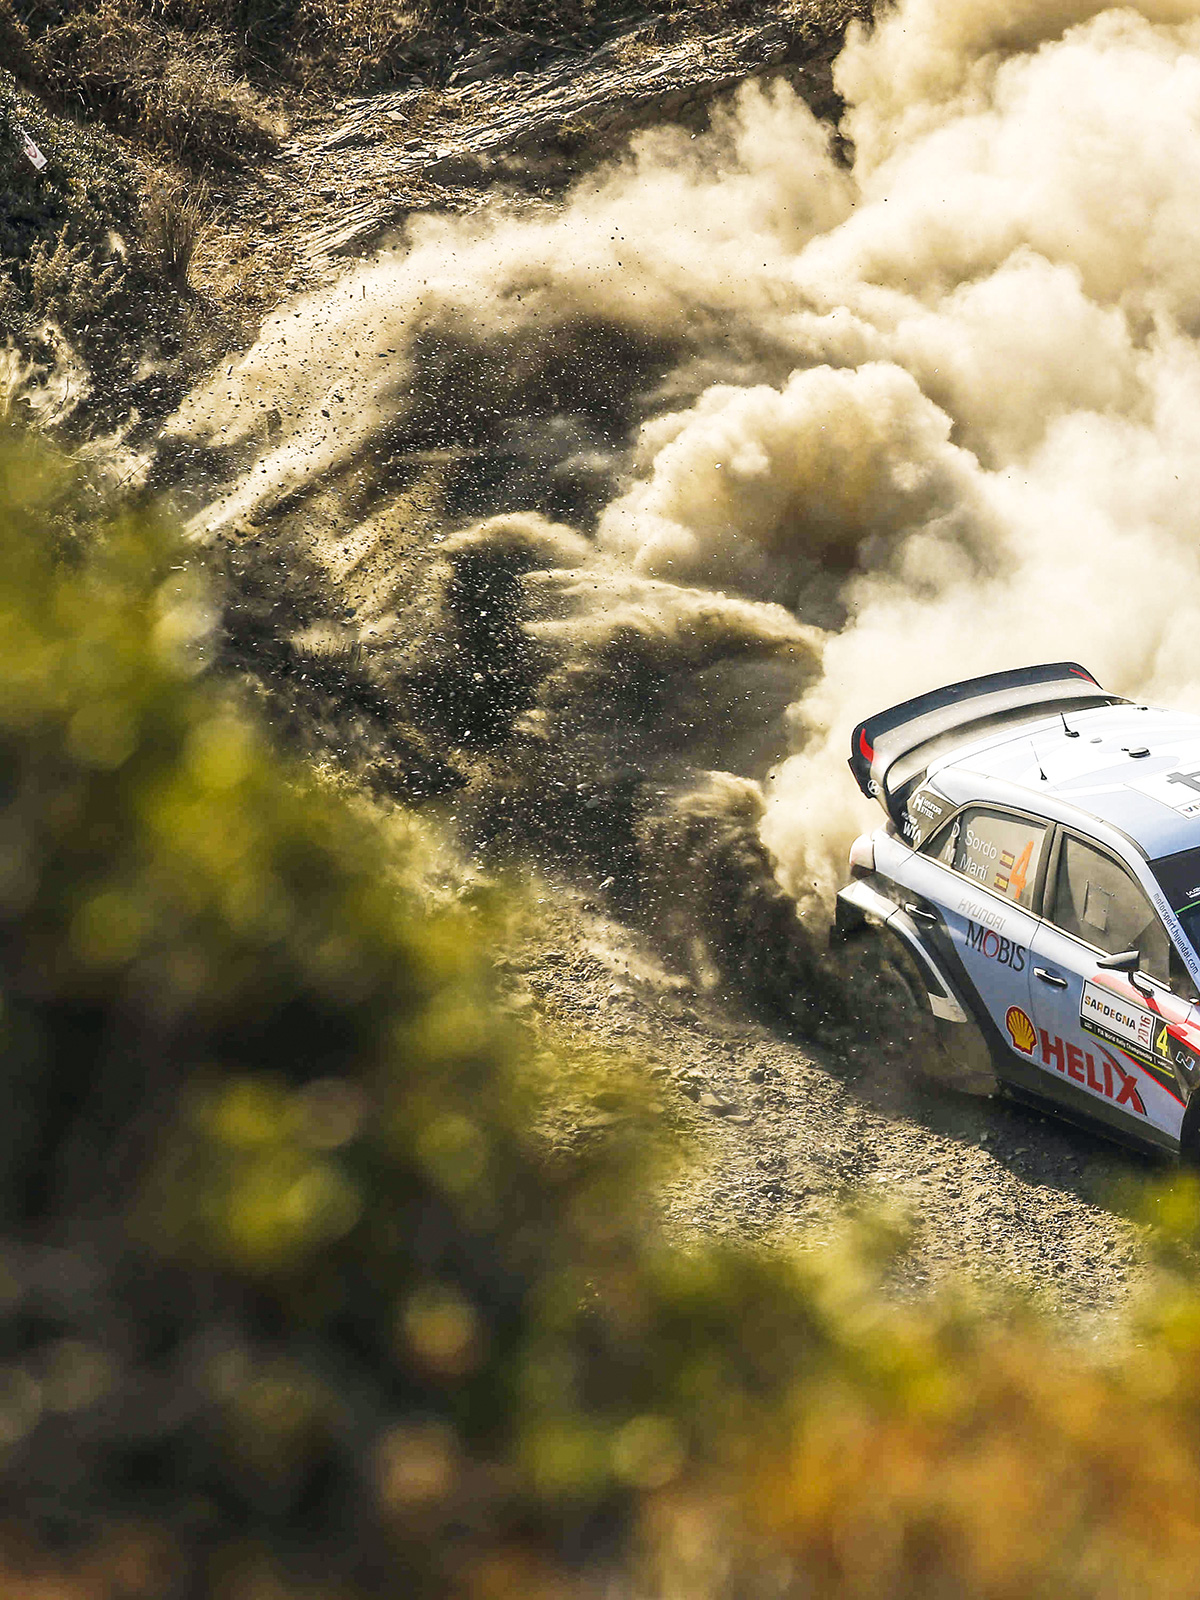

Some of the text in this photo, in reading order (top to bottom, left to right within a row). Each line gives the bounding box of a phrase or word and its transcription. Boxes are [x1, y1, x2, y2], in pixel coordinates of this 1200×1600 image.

[964, 830, 997, 860] Sordo
[960, 853, 989, 881] Martí
[1009, 840, 1034, 899] 4
[958, 898, 1007, 931] HYUNDAI
[964, 920, 1026, 972] MOBIS
[1153, 893, 1199, 975] motorsport.hyundai.com
[1084, 995, 1136, 1030] SARDEGNA
[1137, 1015, 1152, 1045] 2016
[1156, 1024, 1169, 1058] 4
[1038, 1027, 1148, 1116] HELIX
